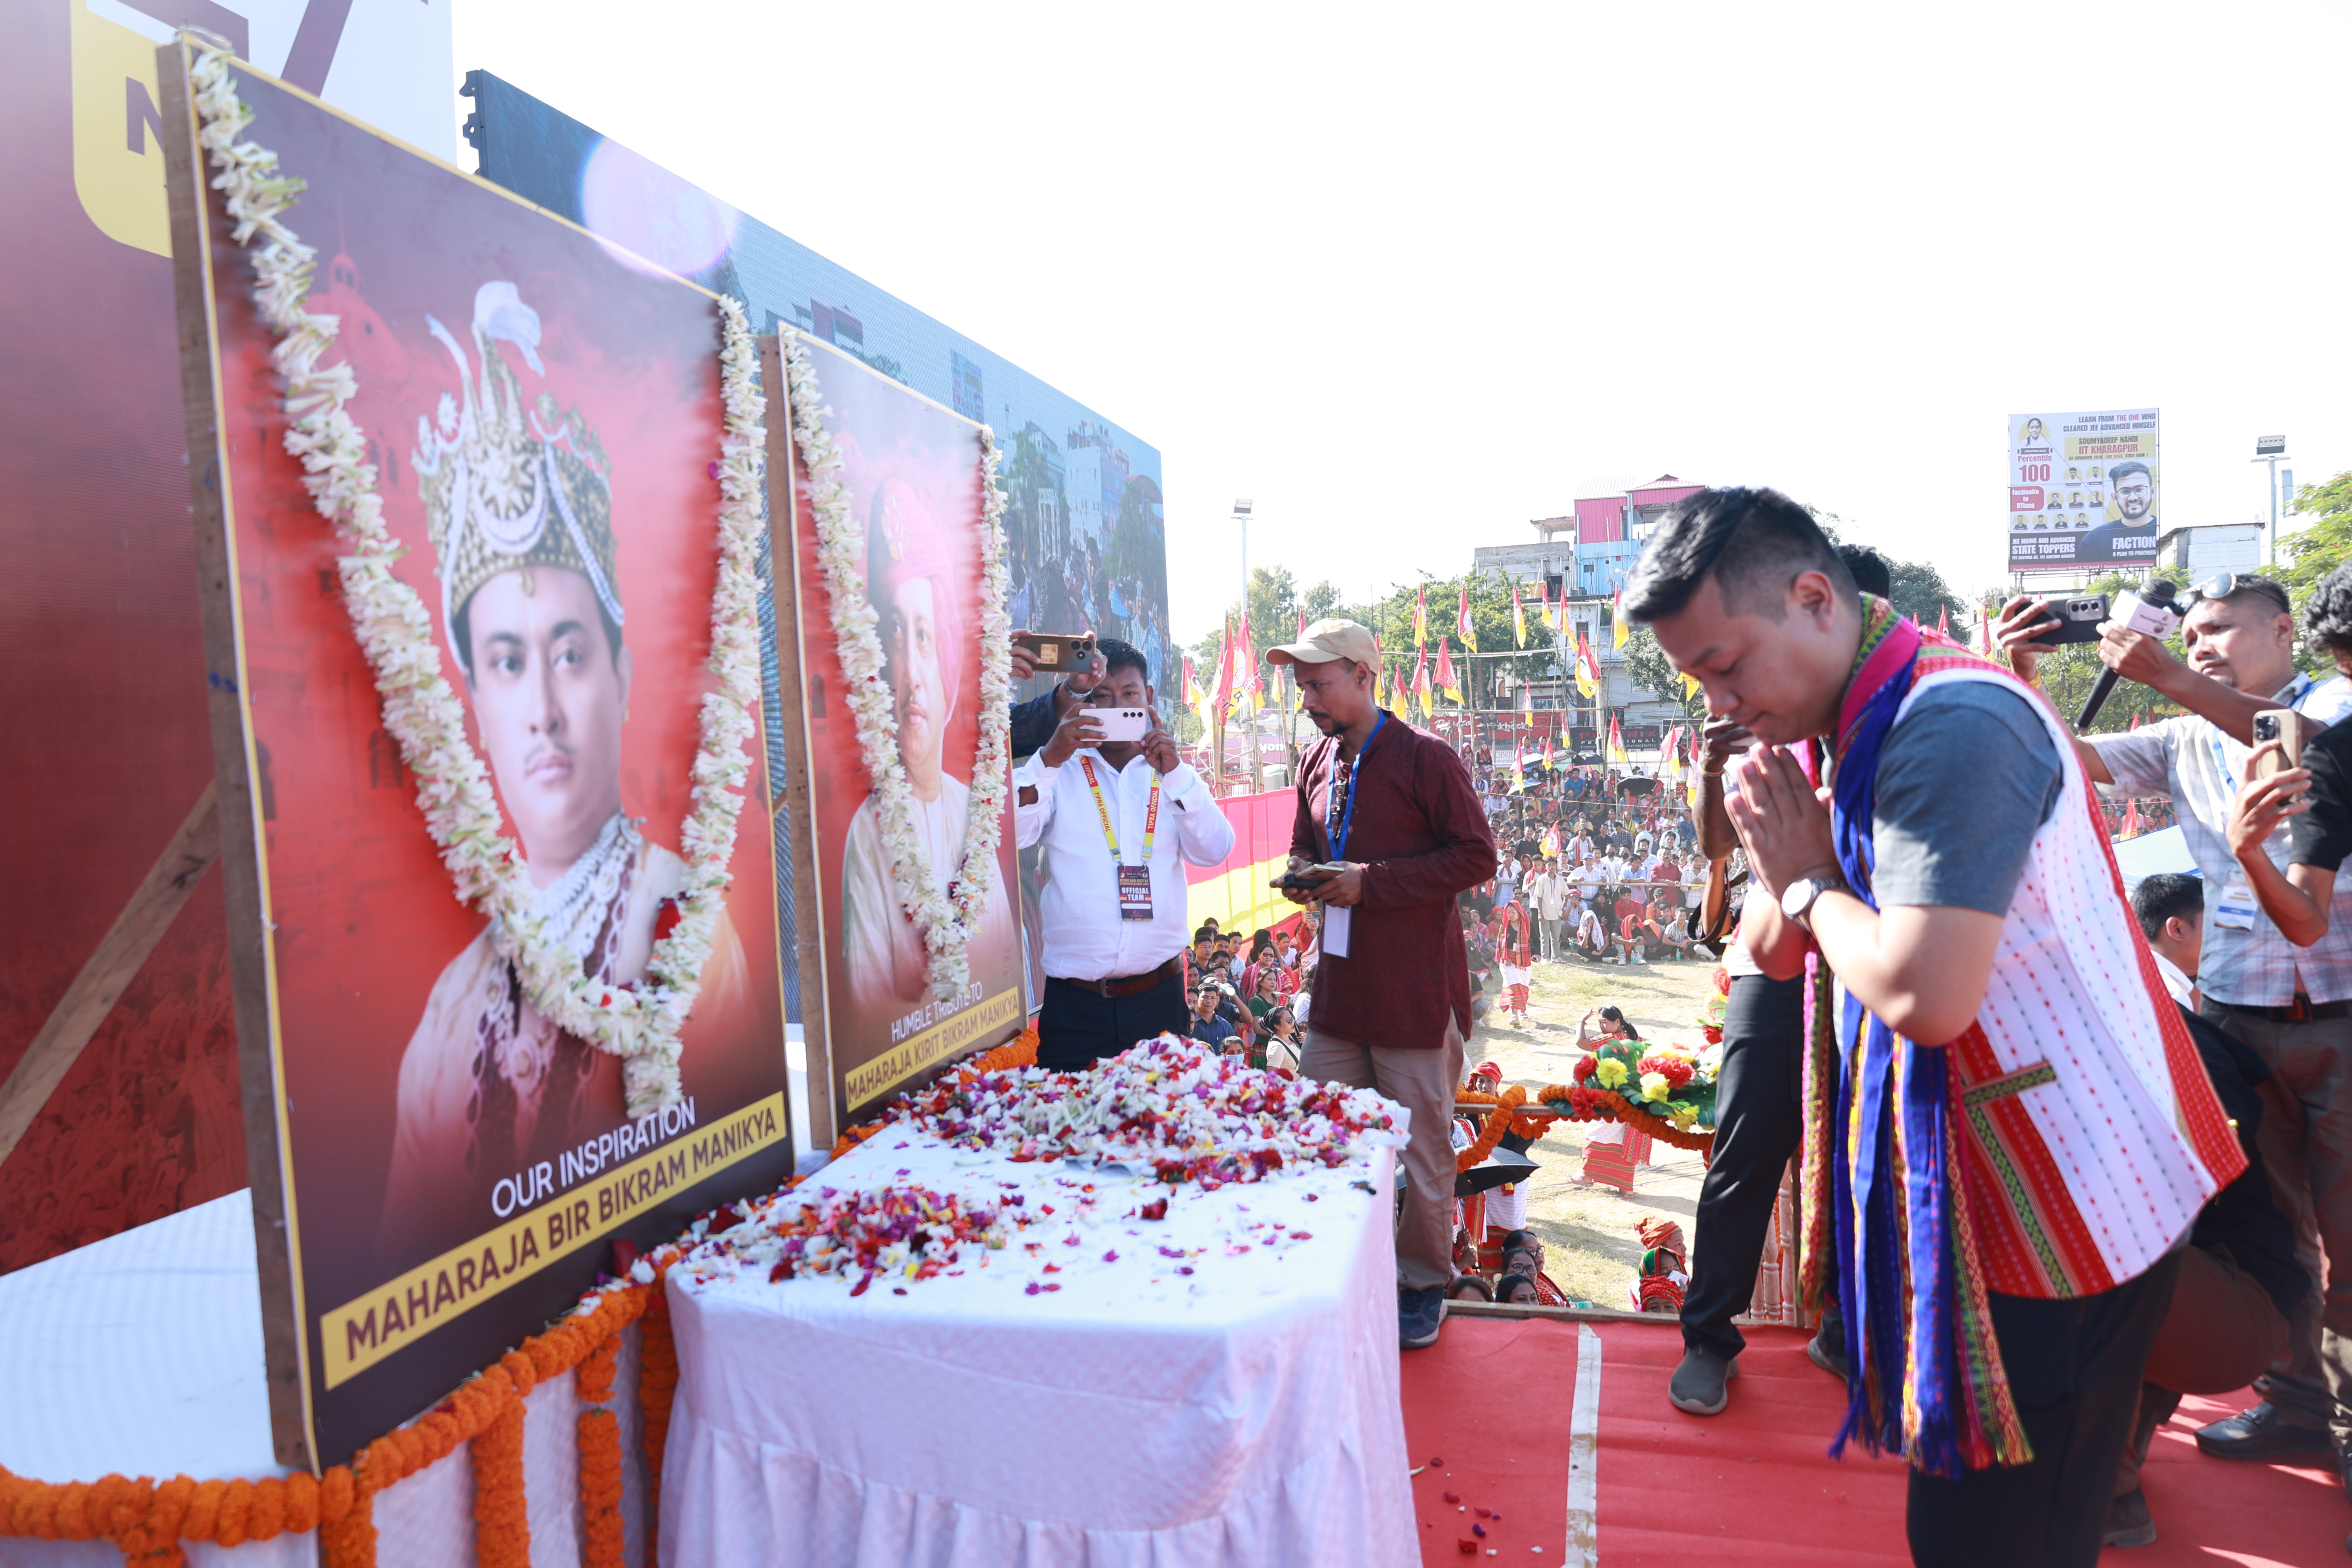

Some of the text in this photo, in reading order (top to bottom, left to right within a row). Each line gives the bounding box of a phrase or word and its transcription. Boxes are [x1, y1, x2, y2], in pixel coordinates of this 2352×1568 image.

[2079, 444, 2138, 454] IIT KHARAGPUR
[2019, 464, 2050, 482] 100
[2012, 543, 2075, 555] STATE TOPPERS
[2112, 536, 2156, 549] FACTION
[1580, 730, 1657, 739] PENIX
[1084, 765, 1095, 785] OFFICIAL
[1094, 792, 1111, 833] TIPRA OFFICIAL
[891, 1005, 933, 1043] HUMBLE
[970, 981, 983, 1002] TO
[847, 993, 1019, 1104] MAHARAJA KIRIT BIKRAM MANIKYA
[491, 1095, 696, 1218] OUR INSPIRATION
[344, 1105, 777, 1362] MAHARAJA BIR BIKRAM MANIKYA
